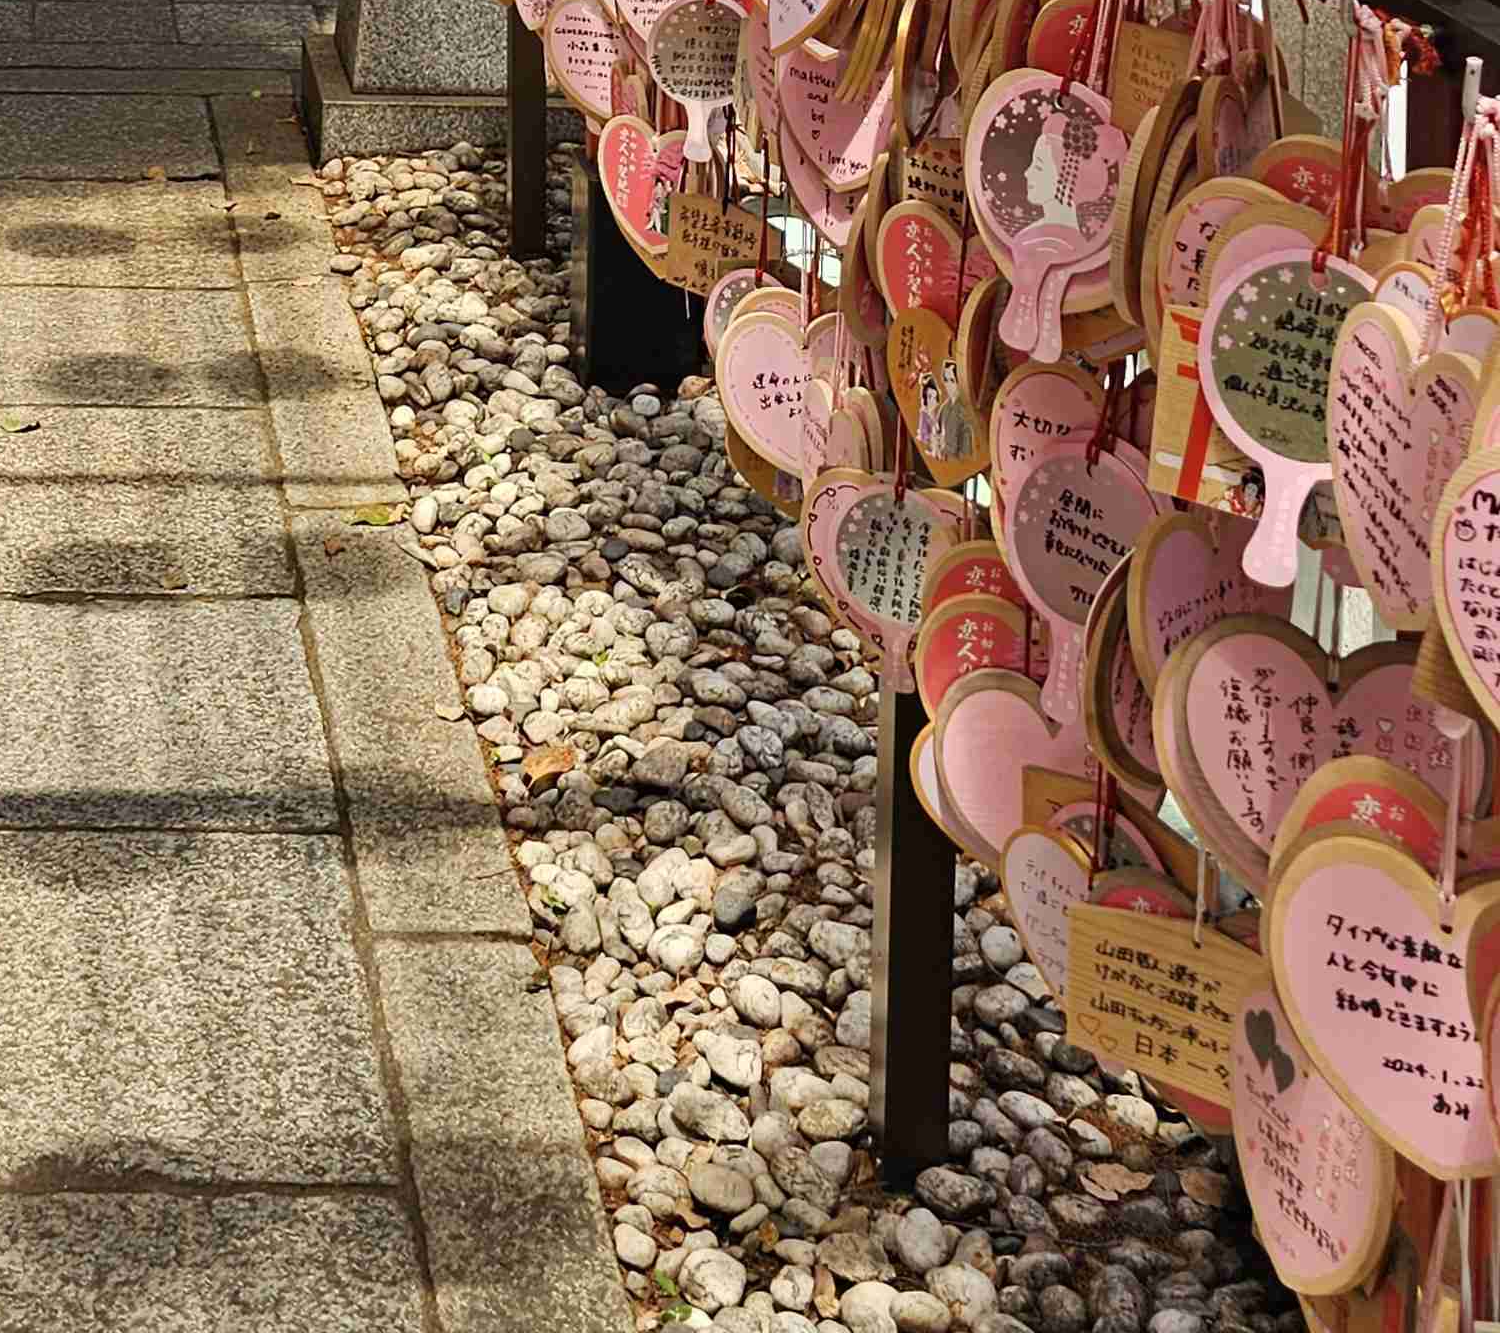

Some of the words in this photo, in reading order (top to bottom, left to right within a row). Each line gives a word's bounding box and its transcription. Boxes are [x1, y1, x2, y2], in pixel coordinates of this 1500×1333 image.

[1350, 793, 1382, 827] 恋
[1334, 989, 1482, 1044] 結婚できますよう
